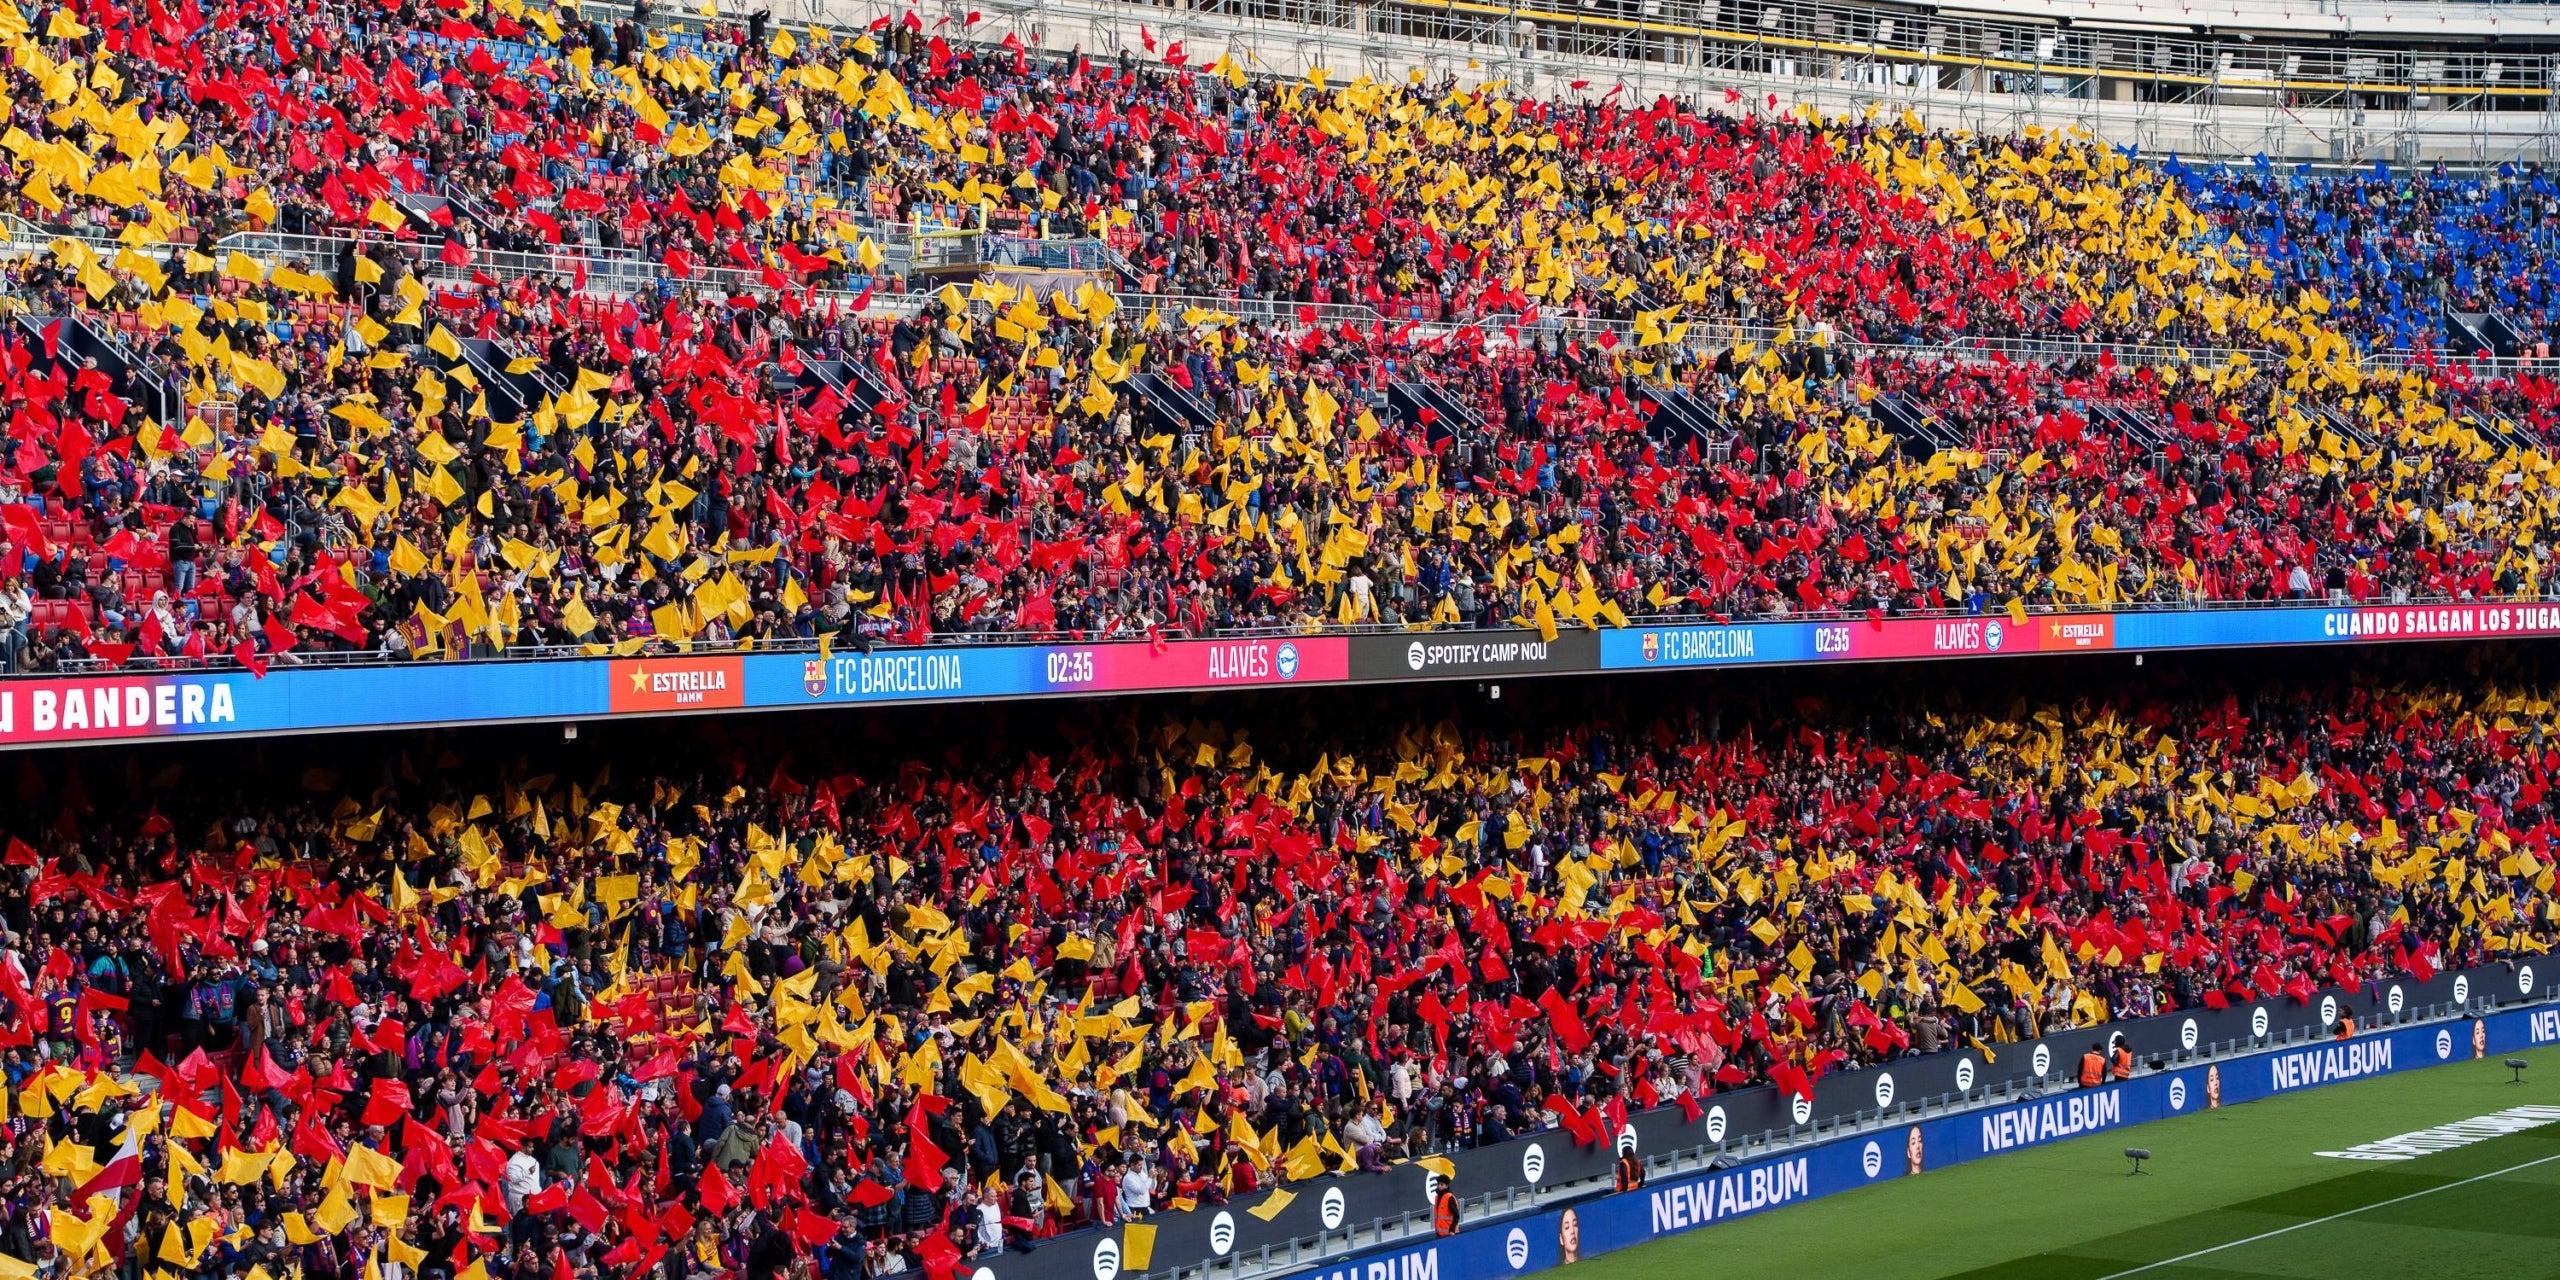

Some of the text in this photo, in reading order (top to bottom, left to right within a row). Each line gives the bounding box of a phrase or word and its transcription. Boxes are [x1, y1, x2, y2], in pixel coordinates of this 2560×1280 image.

[828, 333, 837, 347] 9
[1934, 619, 1980, 650] ALAVÉS
[2062, 623, 2105, 639] ESTRELLA
[2324, 607, 2560, 636] CUANDO SALGAN LOS JUGA
[1427, 642, 1547, 665] SPOTIFY CAMP NOU
[1664, 629, 1754, 660] FC BARCELONA
[1815, 627, 1850, 653] 02:35
[835, 655, 962, 694] FC BARCELONA
[1047, 651, 1094, 683] 02:35
[1208, 640, 1269, 679] ALAVÉS
[652, 670, 726, 693] ESTRELLA
[33, 683, 235, 731] BANDERA
[676, 692, 703, 703] DAMM
[61, 1006, 72, 1024] 9
[2530, 1010, 2560, 1043] NE
[2271, 1038, 2392, 1091] NEW ALBUM
[1982, 1088, 2120, 1152] NEW ALBUM
[1651, 1157, 1808, 1234] NEW ALBUM
